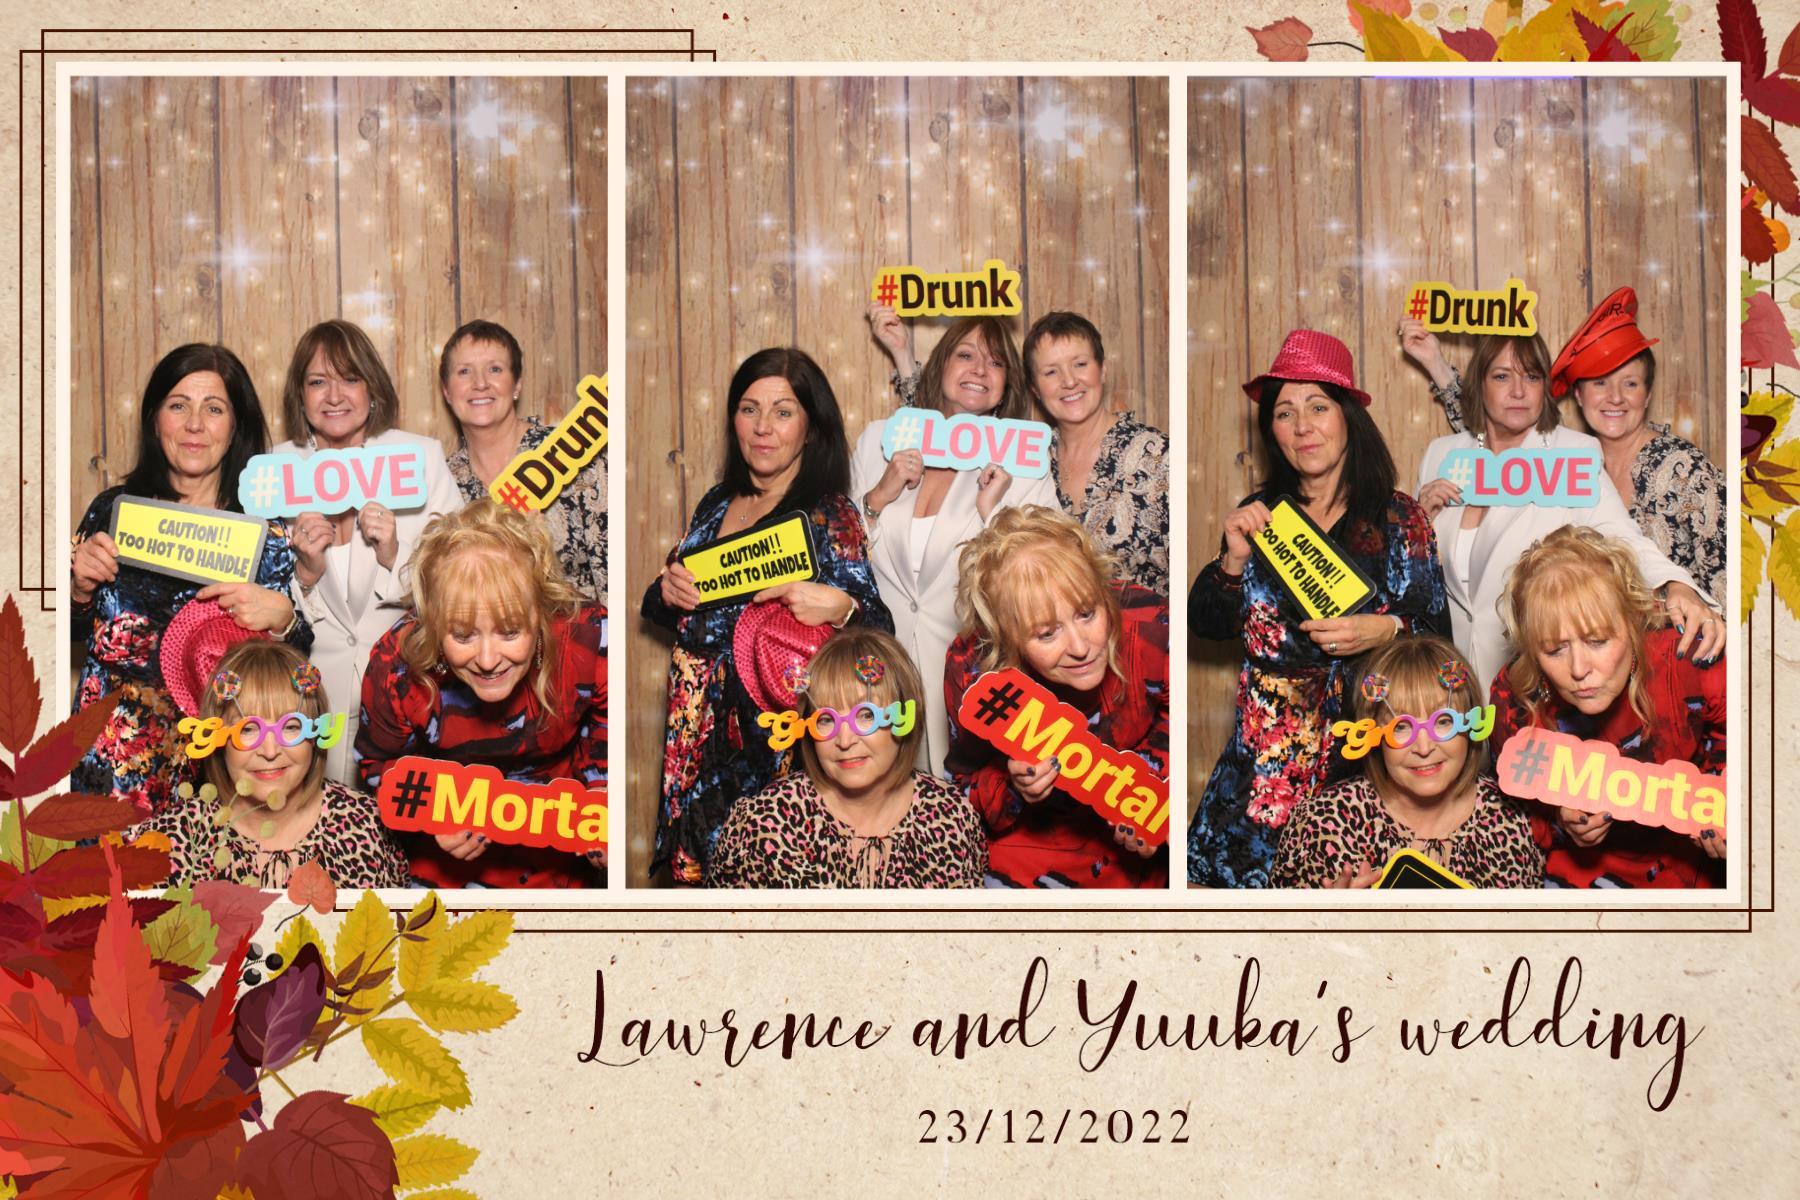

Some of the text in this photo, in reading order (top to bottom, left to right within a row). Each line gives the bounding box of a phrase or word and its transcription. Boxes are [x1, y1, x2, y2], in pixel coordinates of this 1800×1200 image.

[877, 268, 1014, 309] #Drunk
[1409, 288, 1531, 328] #Drunk
[891, 416, 1045, 468] #LOVE
[249, 453, 419, 508] #LOVE
[1448, 457, 1593, 496] #LOVE
[158, 518, 232, 548] CAUTION!!
[720, 532, 783, 568] CAUTION!!
[118, 531, 250, 578] TOO HOT TO HANDLE
[694, 551, 809, 593] TOO HOT TO HANDLE
[1273, 541, 1297, 566] HOT
[1289, 561, 1307, 580] TO
[1292, 533, 1346, 589] CAUTION!!
